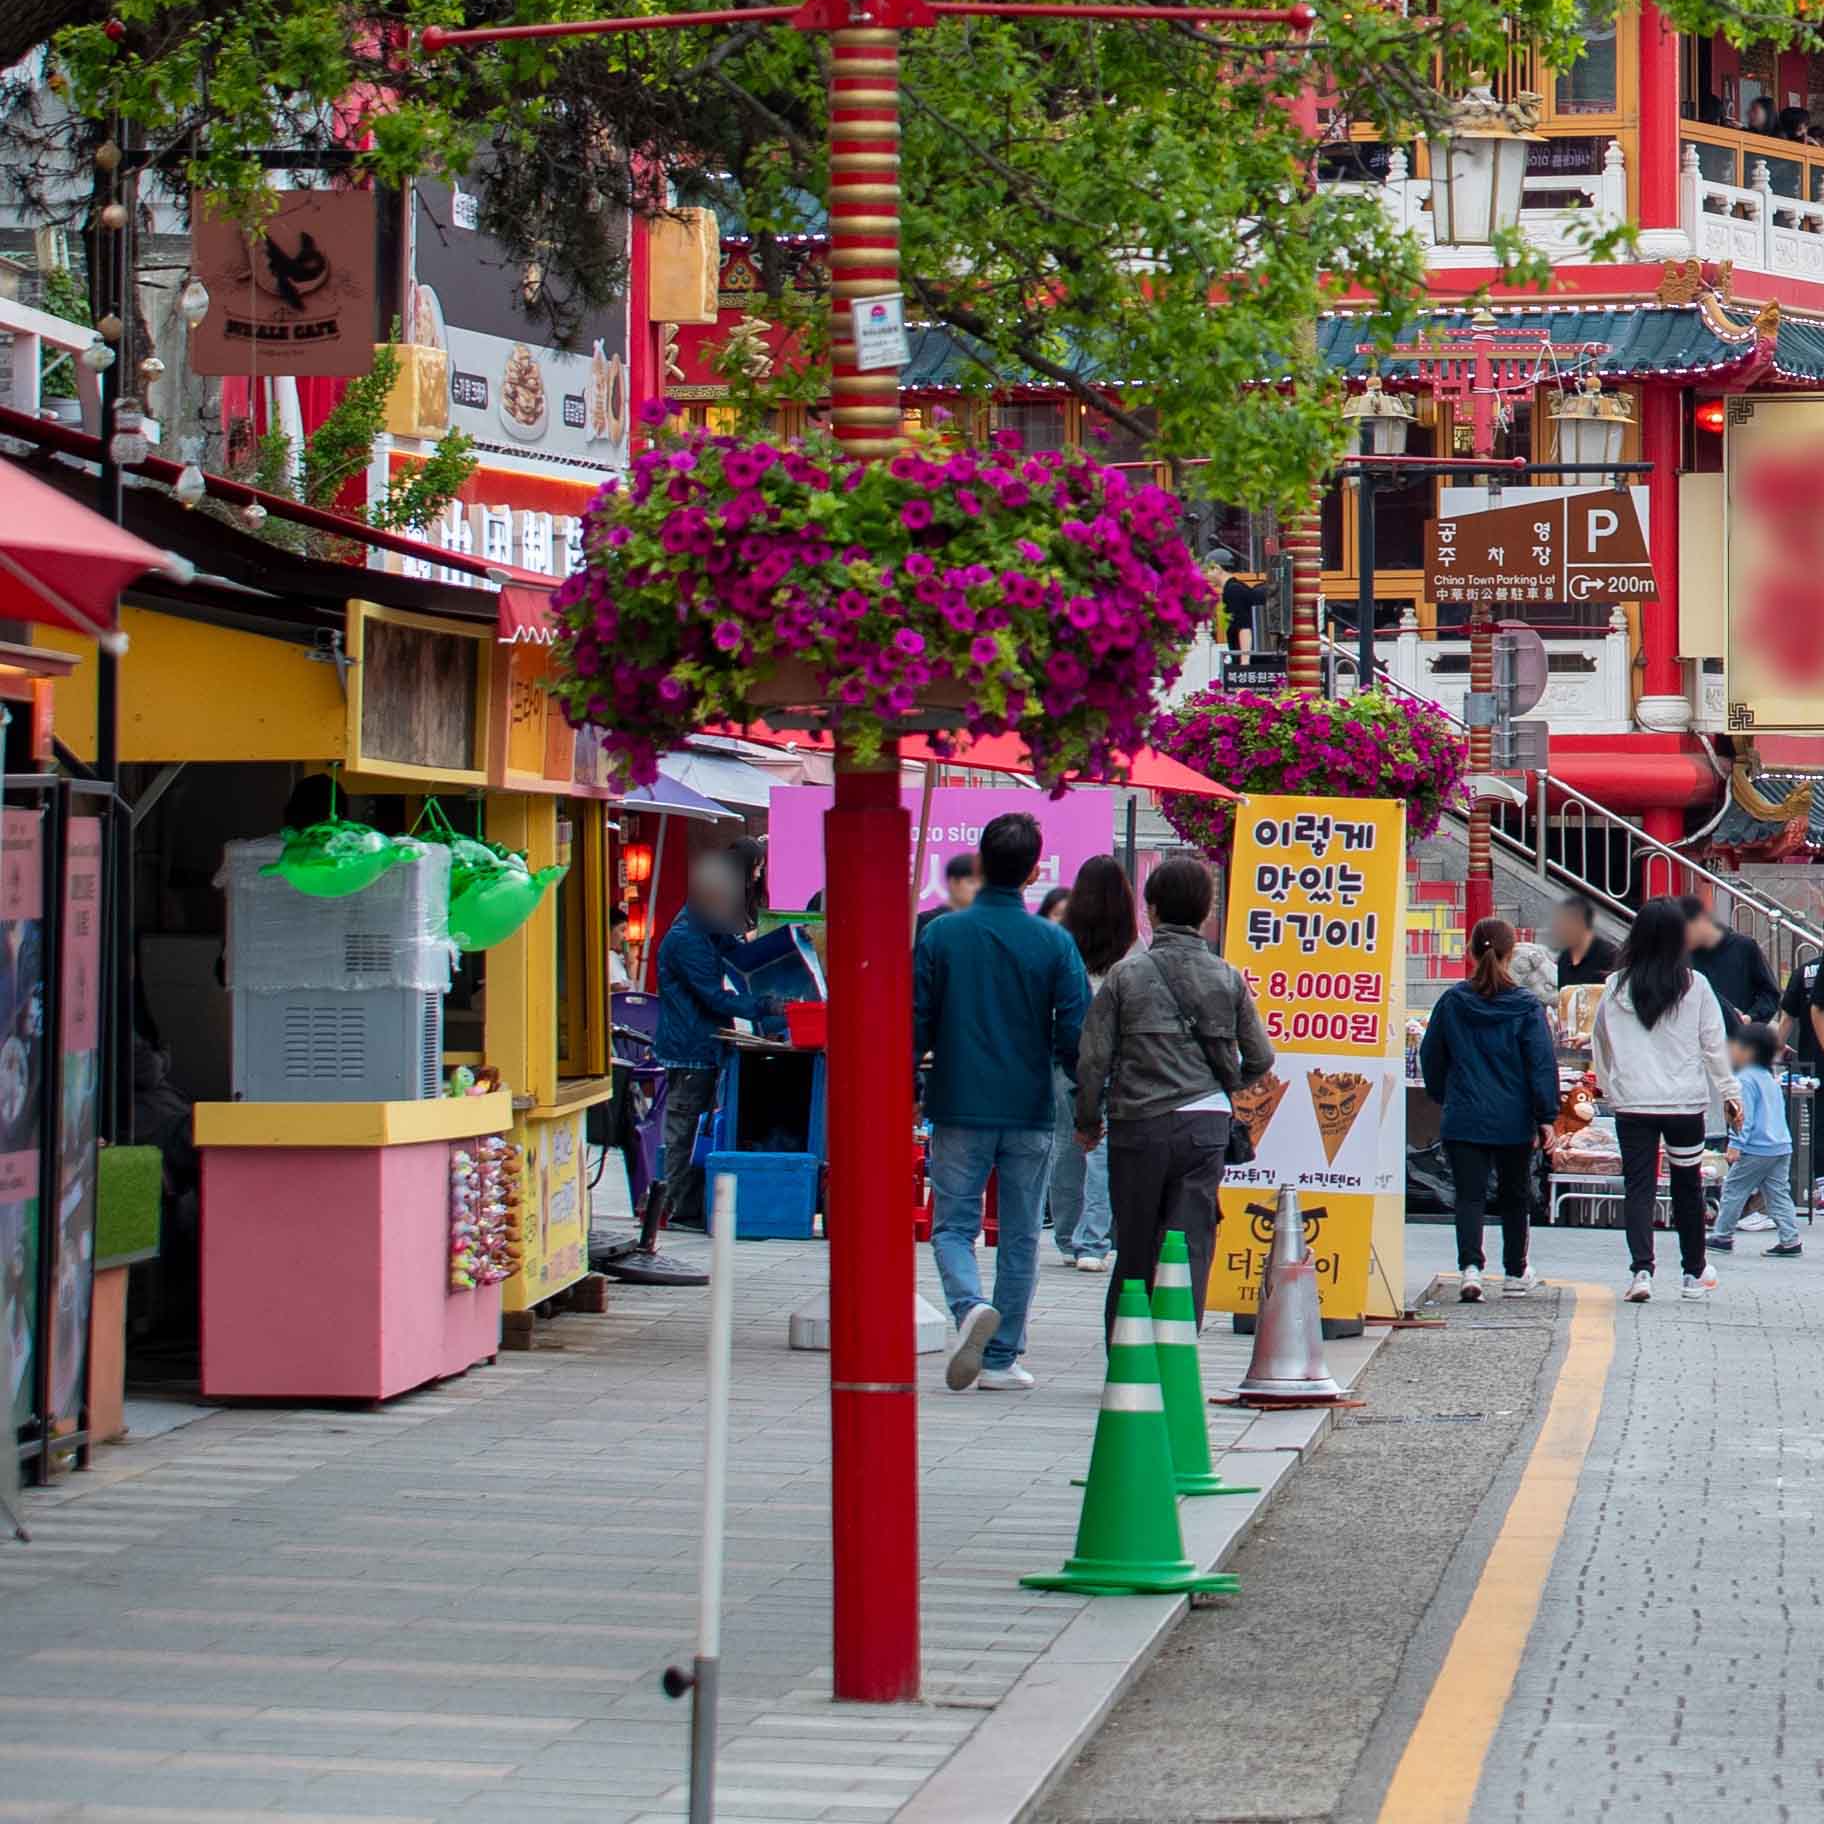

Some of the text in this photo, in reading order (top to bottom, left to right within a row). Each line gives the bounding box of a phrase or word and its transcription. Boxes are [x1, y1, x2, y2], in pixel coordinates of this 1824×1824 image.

[1587, 508, 1619, 553] P
[1433, 574, 1556, 588] China Town Parking Lot
[1607, 576, 1655, 593] 200m
[1254, 814, 1377, 857] 이렇게
[1256, 862, 1364, 906] 맛있는
[1247, 909, 1378, 953] 튀김이!
[1268, 971, 1382, 1004] 8,000원
[1266, 1011, 1378, 1045] 5,000원
